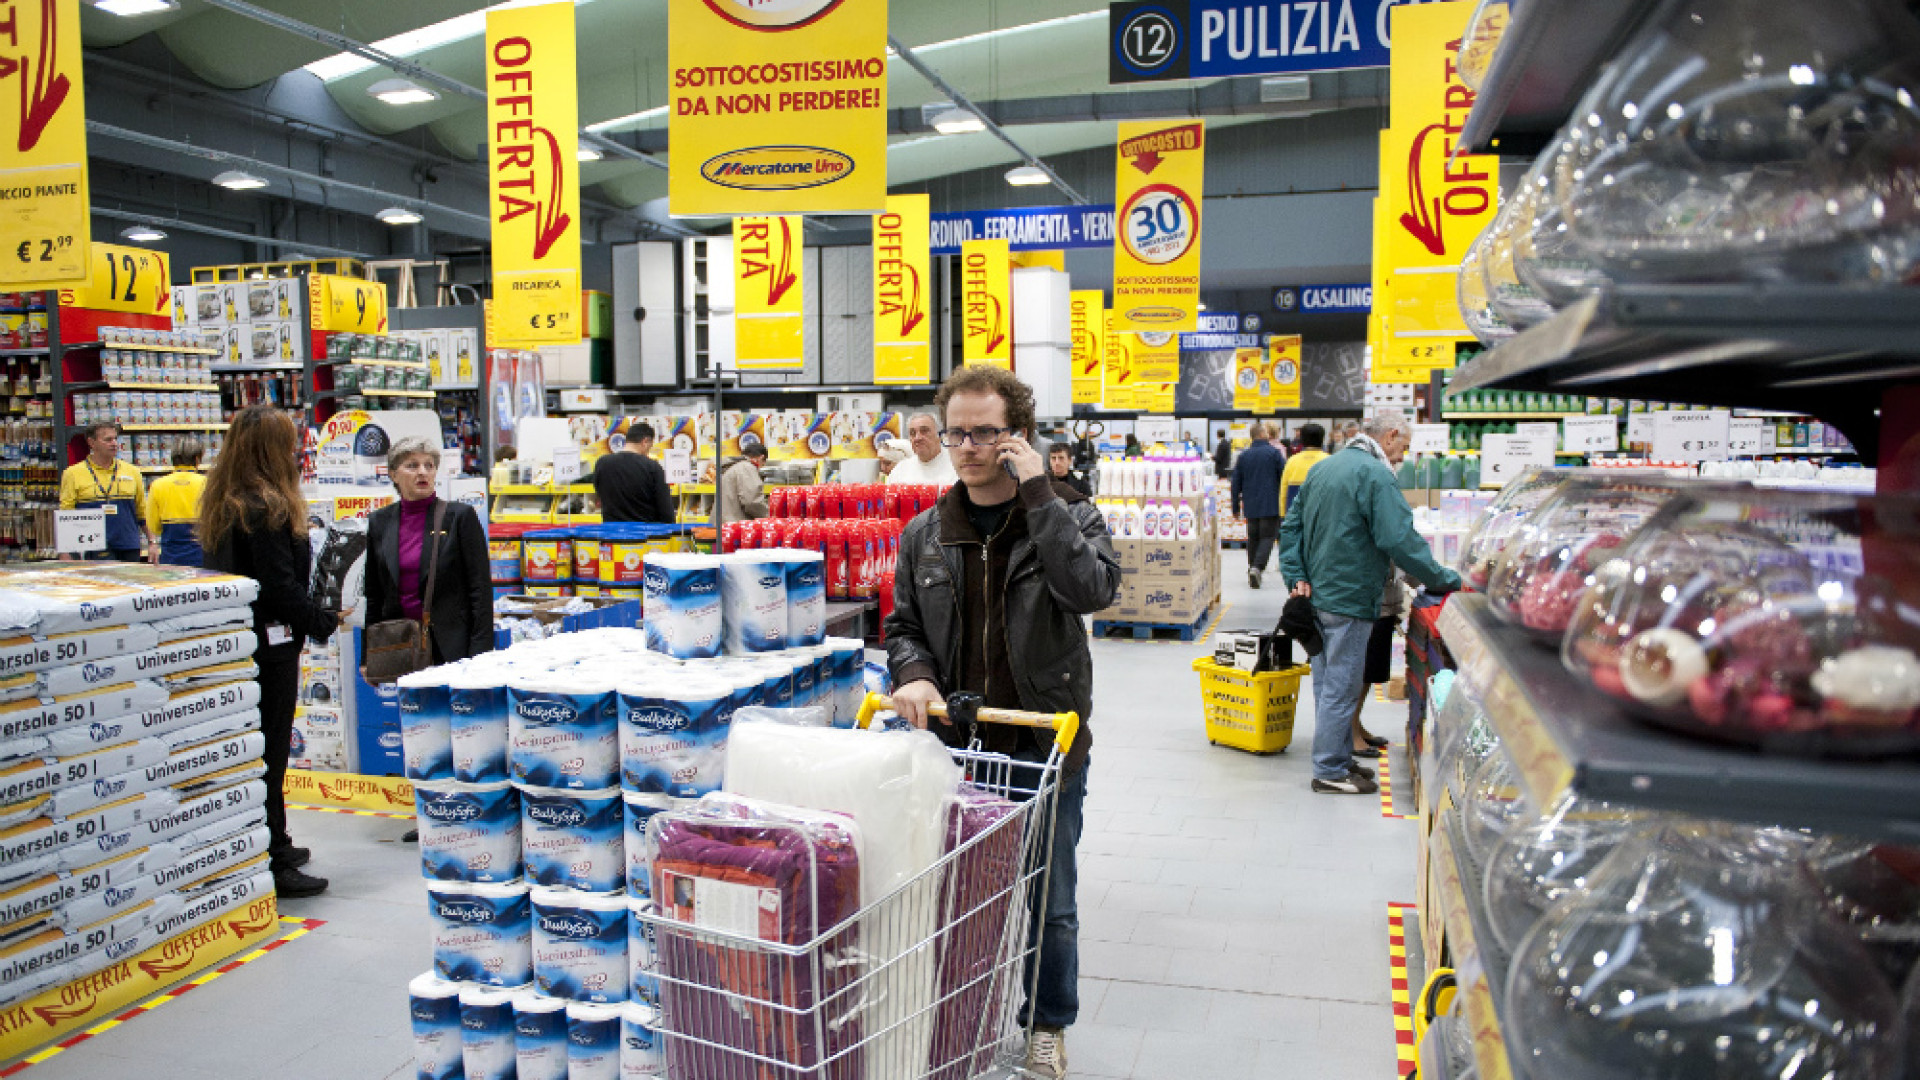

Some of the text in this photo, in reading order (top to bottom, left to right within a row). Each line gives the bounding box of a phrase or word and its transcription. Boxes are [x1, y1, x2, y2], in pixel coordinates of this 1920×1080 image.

[1132, 23, 1166, 57] 12
[1202, 0, 1361, 62] PULIZIA
[675, 58, 884, 89] SOTTOCOSTISSIMO
[678, 88, 881, 117] DA NON PERDERE!
[494, 36, 535, 224] OFFERTA
[1123, 130, 1195, 157] SOTTOCOSTO
[713, 159, 844, 177] Mercatone Uno
[0, 184, 78, 200] ICCIO PIANTE
[930, 219, 973, 248] RDINO
[985, 214, 1071, 244] FERRAMENTA
[17, 240, 32, 263] €
[741, 216, 769, 279] RTA
[879, 213, 903, 317] OFFERTA
[512, 280, 562, 291] RICARICA
[966, 253, 988, 339] OFFERTA
[1070, 300, 1087, 362] OFFERTA
[337, 498, 371, 510] SUPER
[132, 584, 210, 613] Universale
[214, 585, 232, 600] 50
[56, 641, 78, 659] 50
[136, 643, 212, 671] Universale
[216, 638, 233, 655] 50
[64, 704, 85, 723] 50
[141, 696, 216, 728] Universale
[220, 691, 237, 707] 50
[66, 763, 88, 782] 50
[145, 752, 220, 782] Universale
[223, 744, 240, 760] 50
[335, 778, 380, 795] OFFERTA
[149, 798, 224, 835] Universale
[225, 789, 243, 807] 50
[76, 819, 96, 839] 50
[154, 848, 228, 887] Universale
[230, 839, 247, 856] 50
[81, 874, 101, 894] 50
[231, 885, 248, 901] 50
[85, 929, 106, 949] 50
[162, 920, 228, 961] OFFERTA
[60, 962, 133, 1006] OFFERTA
